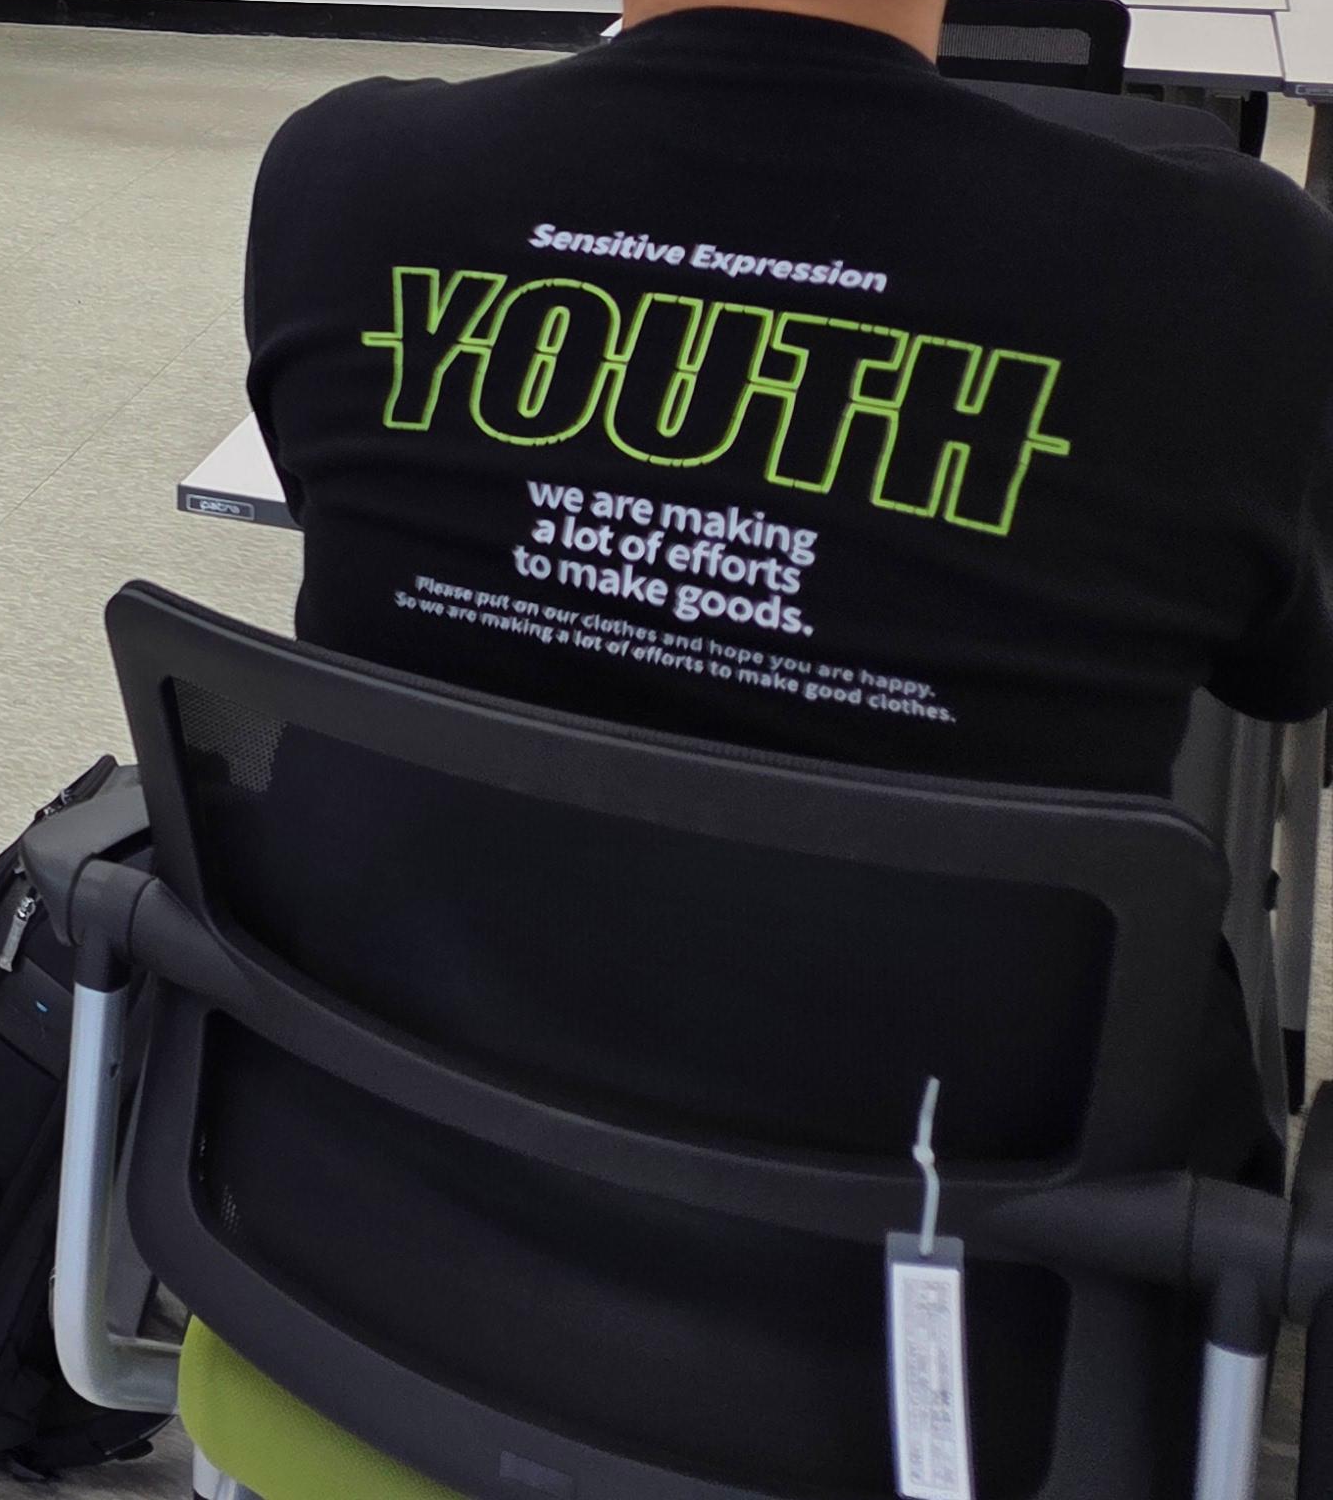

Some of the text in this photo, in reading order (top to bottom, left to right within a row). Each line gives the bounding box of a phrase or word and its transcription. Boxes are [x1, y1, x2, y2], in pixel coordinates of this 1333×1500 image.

[528, 223, 887, 292] Sensitive Expression
[361, 266, 1070, 536] YOUTH
[527, 480, 818, 566] we are making
[533, 516, 801, 594] a lot of efforts
[415, 575, 936, 699] Please put on our clothes and hope you are happy.
[513, 545, 814, 637] to make goods.
[395, 590, 957, 723] So we are making a lot of efforts to make good clothes.
